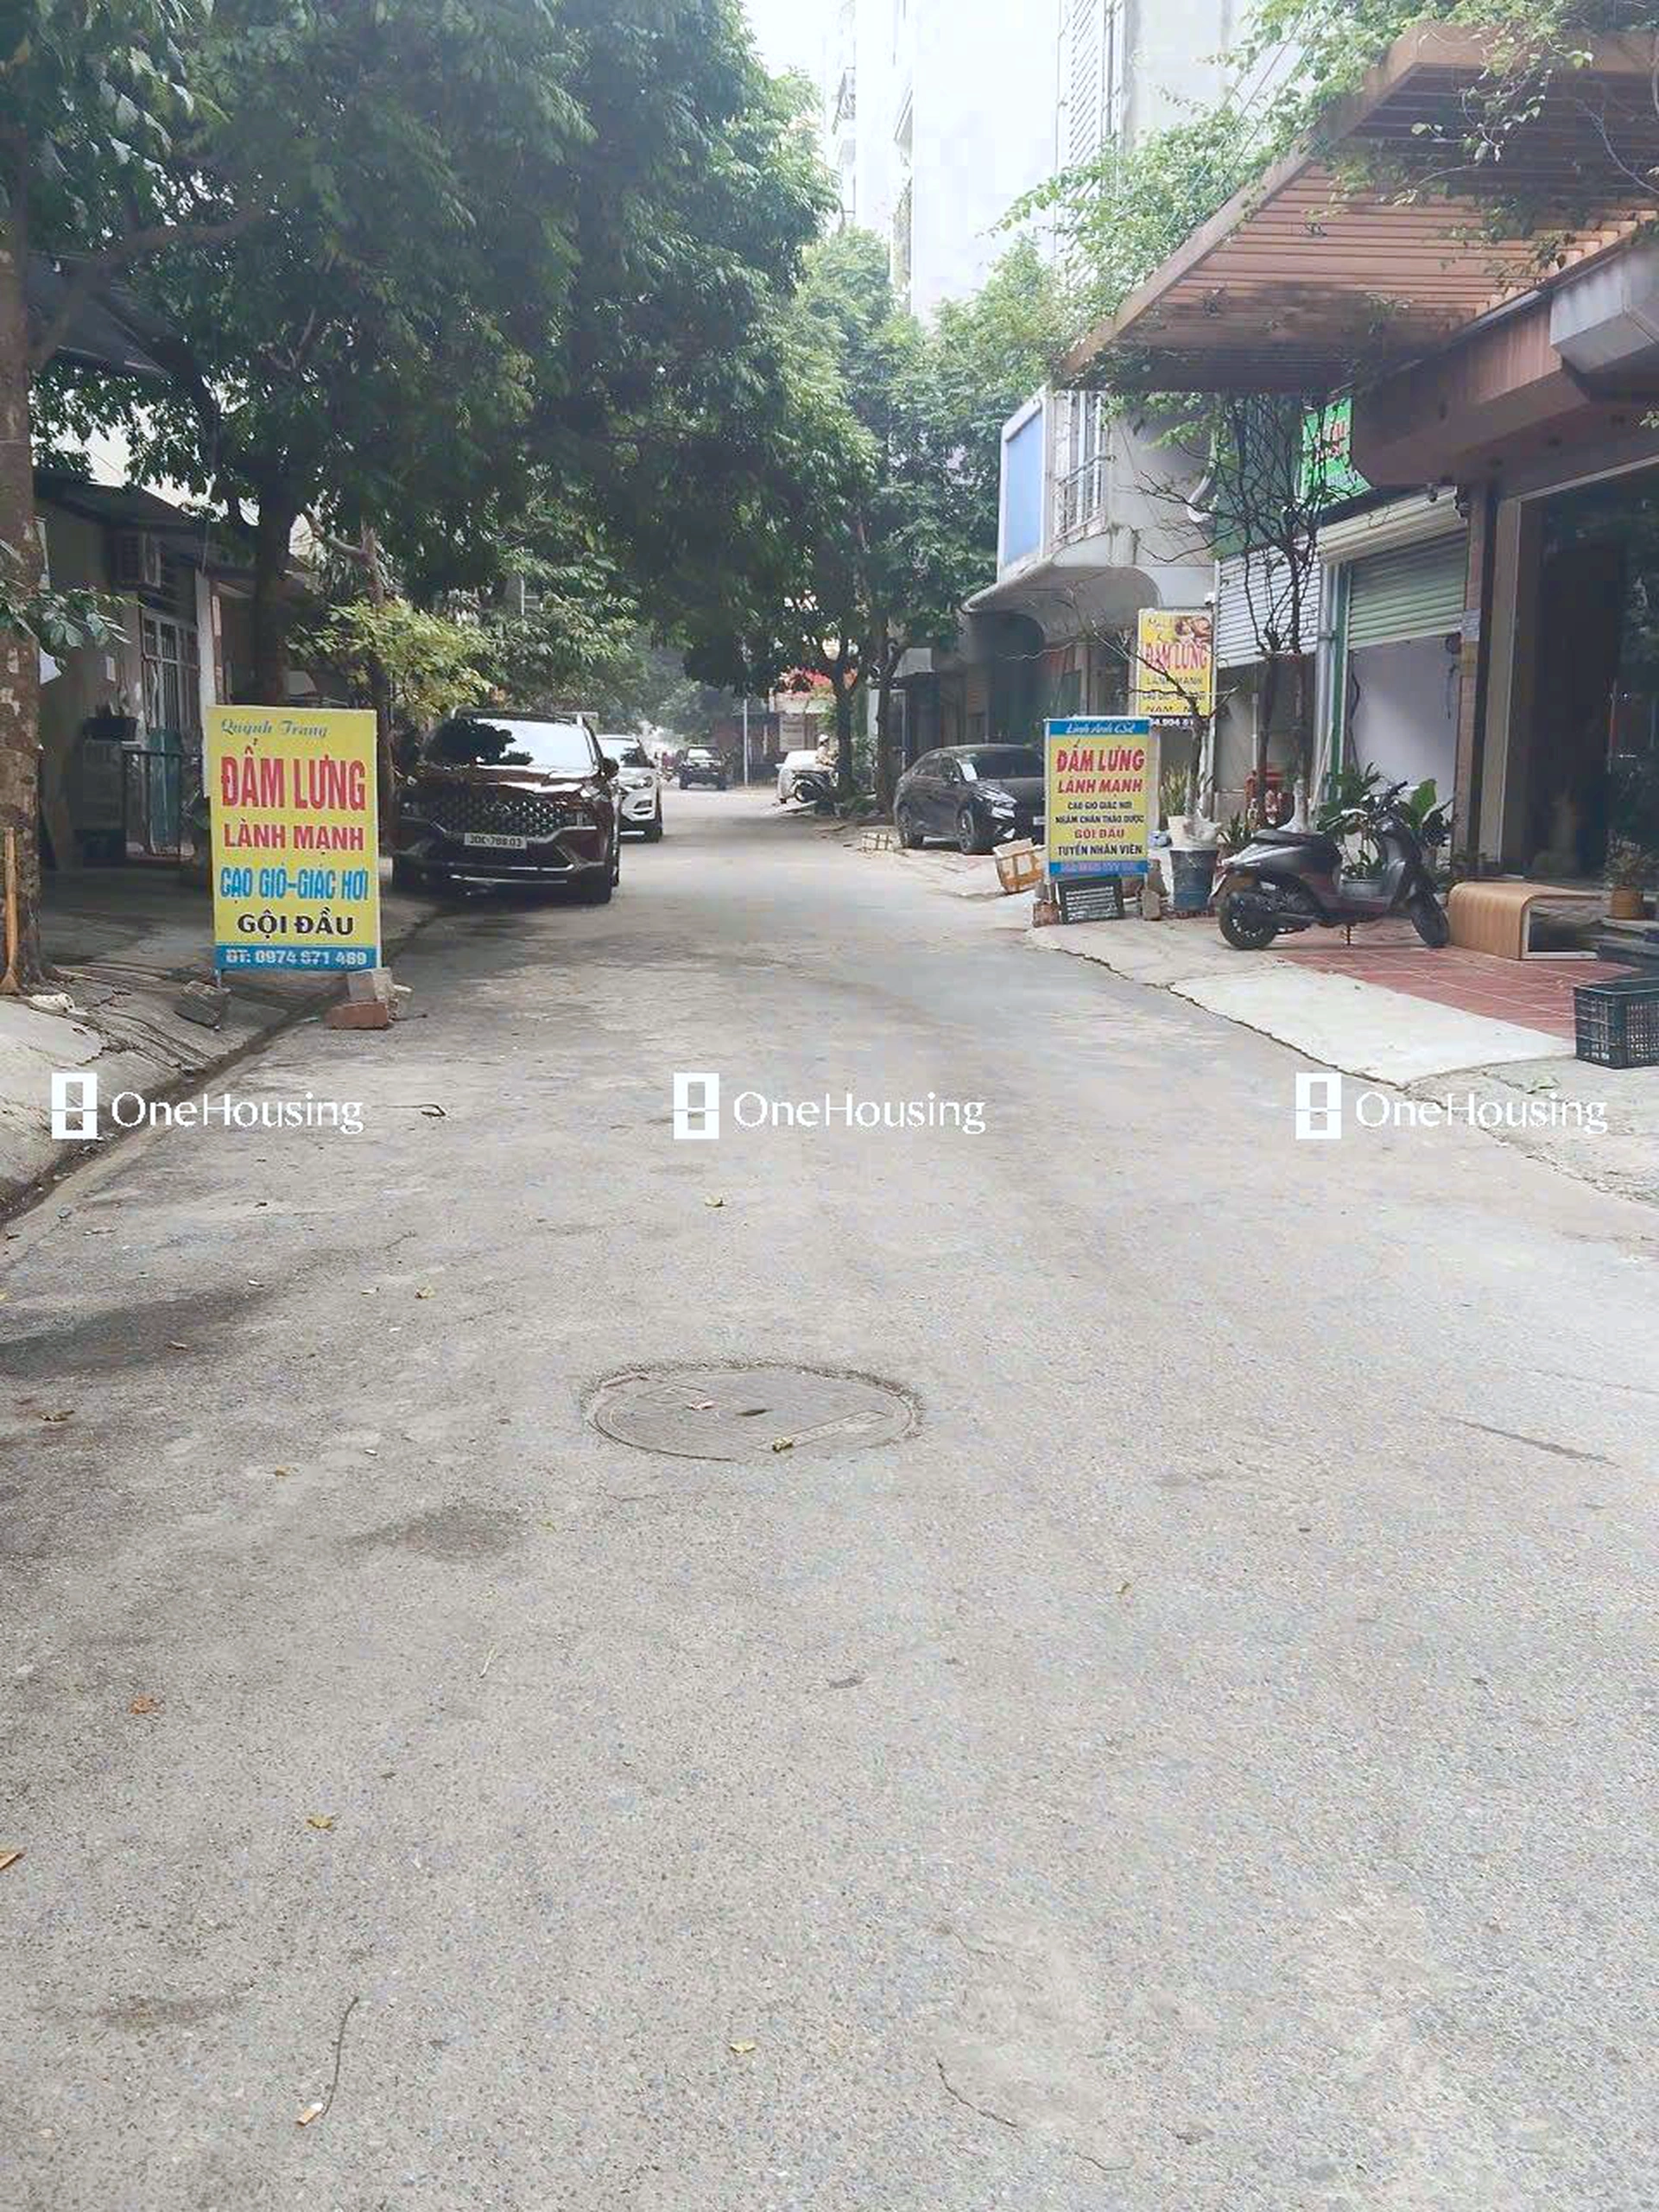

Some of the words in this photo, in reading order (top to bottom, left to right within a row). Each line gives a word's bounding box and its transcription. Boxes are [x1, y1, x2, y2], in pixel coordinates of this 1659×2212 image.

[1098, 745, 1145, 771] LƯNG
[294, 754, 366, 811] LƯNG
[224, 817, 286, 848] LÀNH
[294, 826, 364, 855] MẠNH
[341, 867, 369, 901] HƠI
[237, 910, 288, 939] GỘI
[294, 907, 354, 935] ĐẦU
